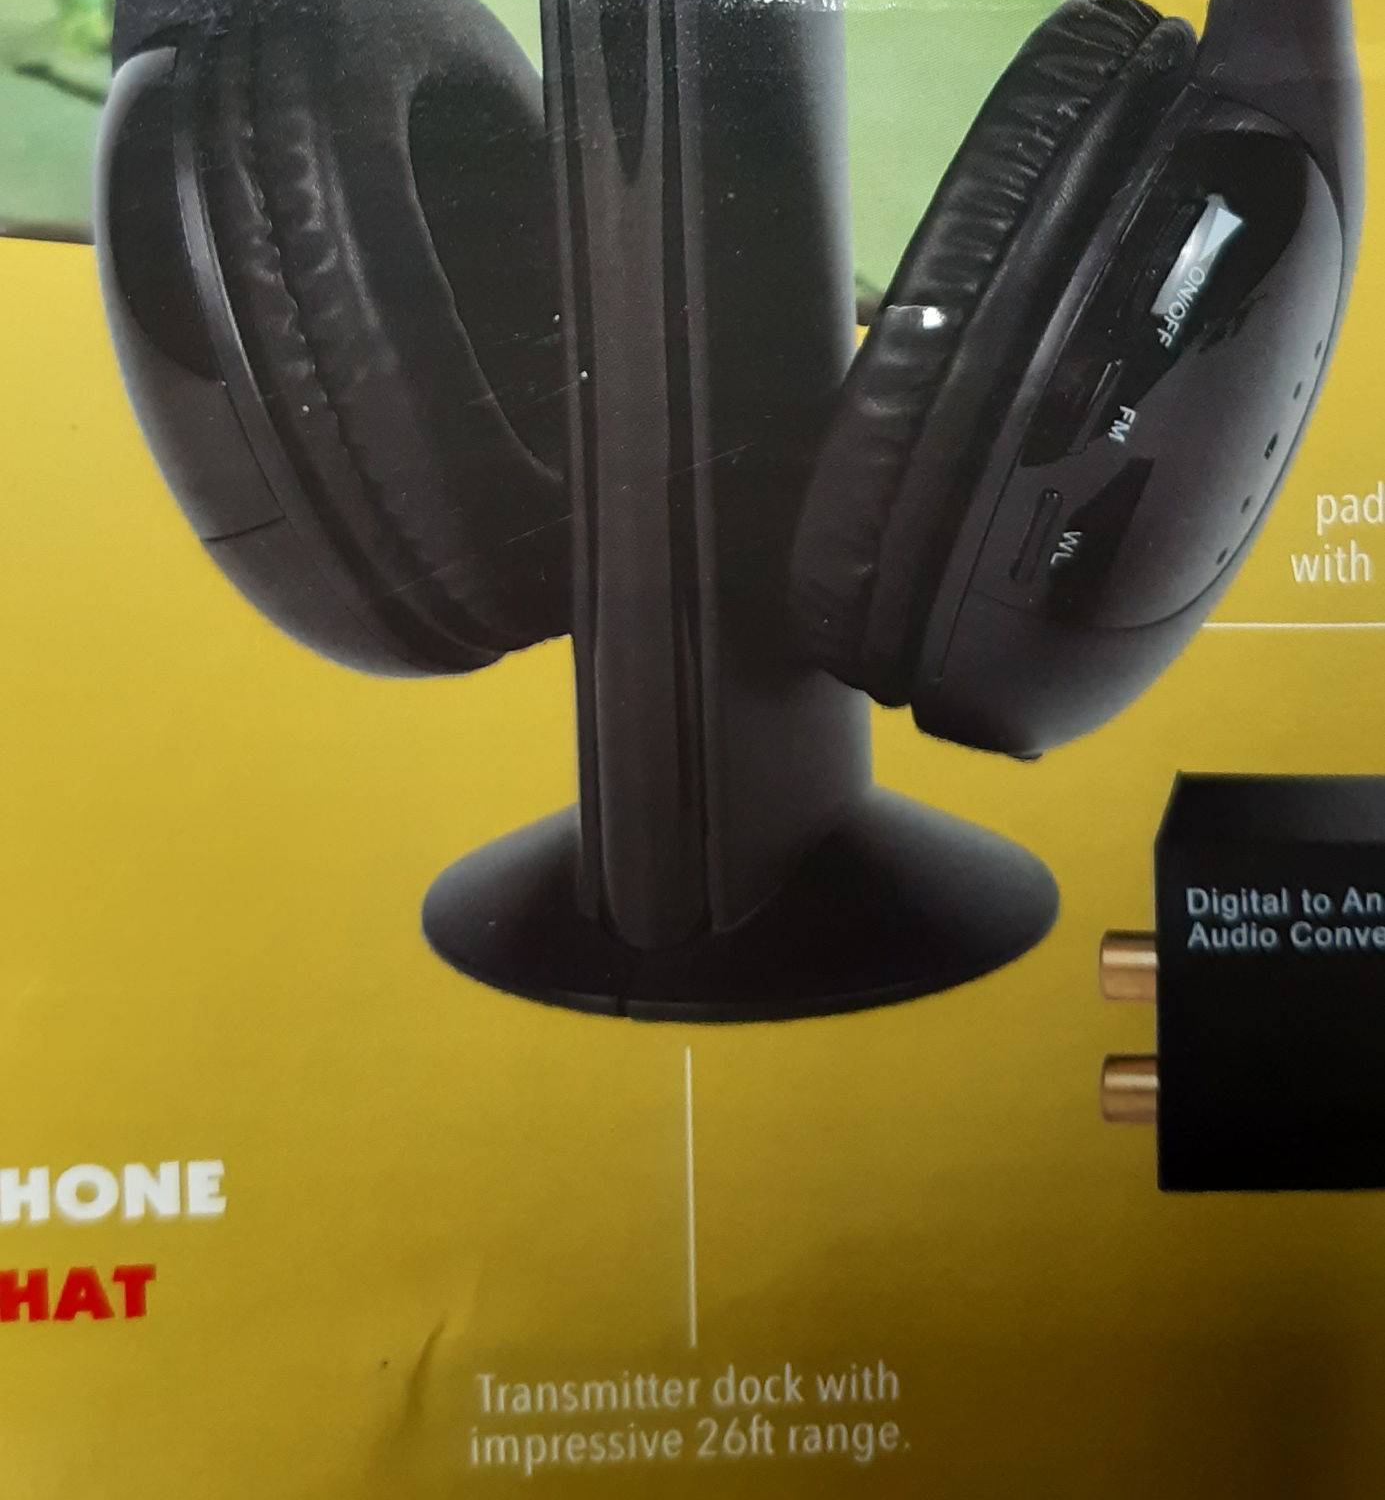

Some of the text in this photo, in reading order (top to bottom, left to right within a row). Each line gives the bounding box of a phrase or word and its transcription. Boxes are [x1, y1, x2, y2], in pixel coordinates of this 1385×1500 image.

[1156, 266, 1206, 349] ON/OFF
[1108, 405, 1137, 444] FM
[1316, 480, 1385, 536] pad
[1050, 530, 1083, 566] WL
[1290, 539, 1373, 583] with
[1186, 887, 1383, 920] Digital to An
[1187, 921, 1385, 948] Audio Conve
[0, 1160, 227, 1222] HONE
[0, 1263, 156, 1322] HAT
[477, 1359, 899, 1414] Transmitter dock with
[471, 1414, 911, 1477] impressive 26ft range.
